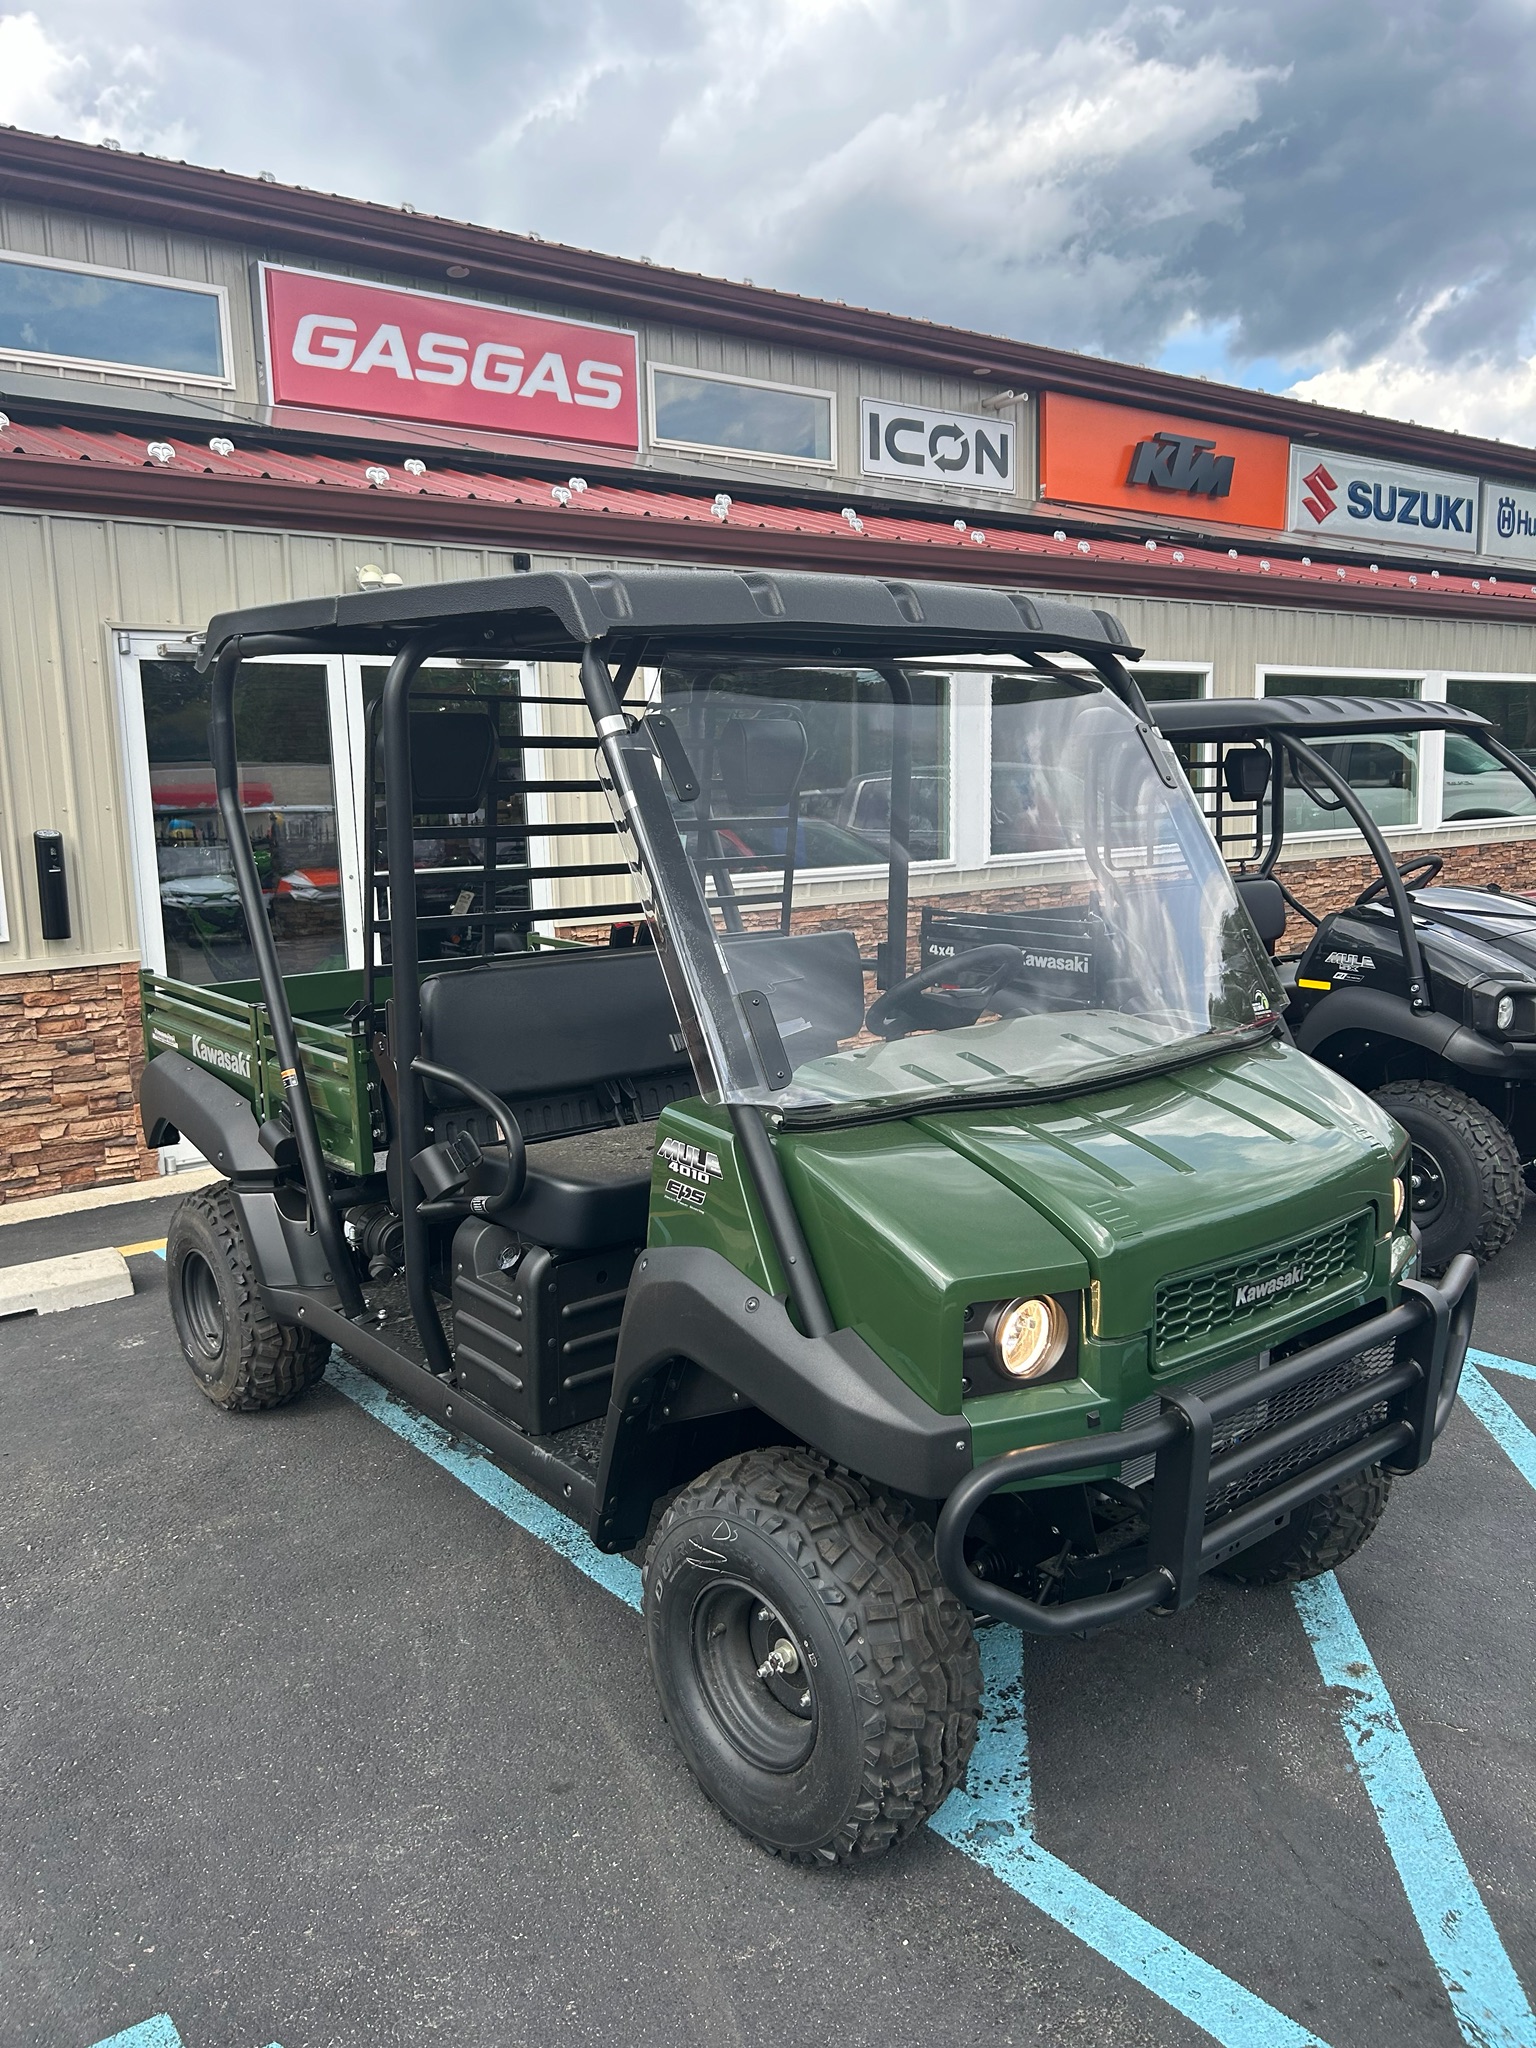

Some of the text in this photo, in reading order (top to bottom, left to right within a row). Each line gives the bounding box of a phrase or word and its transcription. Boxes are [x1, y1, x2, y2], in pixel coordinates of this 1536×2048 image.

[292, 313, 624, 410] GASGAS
[869, 412, 1009, 479] ICON
[1126, 431, 1235, 498] KTM
[1347, 480, 1473, 533] SUZUKI
[929, 944, 955, 957] 4x4
[1324, 951, 1376, 970] MULE
[192, 1034, 252, 1079] Kawasaki
[657, 1137, 723, 1180] MULE
[668, 1161, 711, 1185] 4010
[665, 1178, 707, 1206] EPS
[1235, 1263, 1306, 1307] Kawasaki
